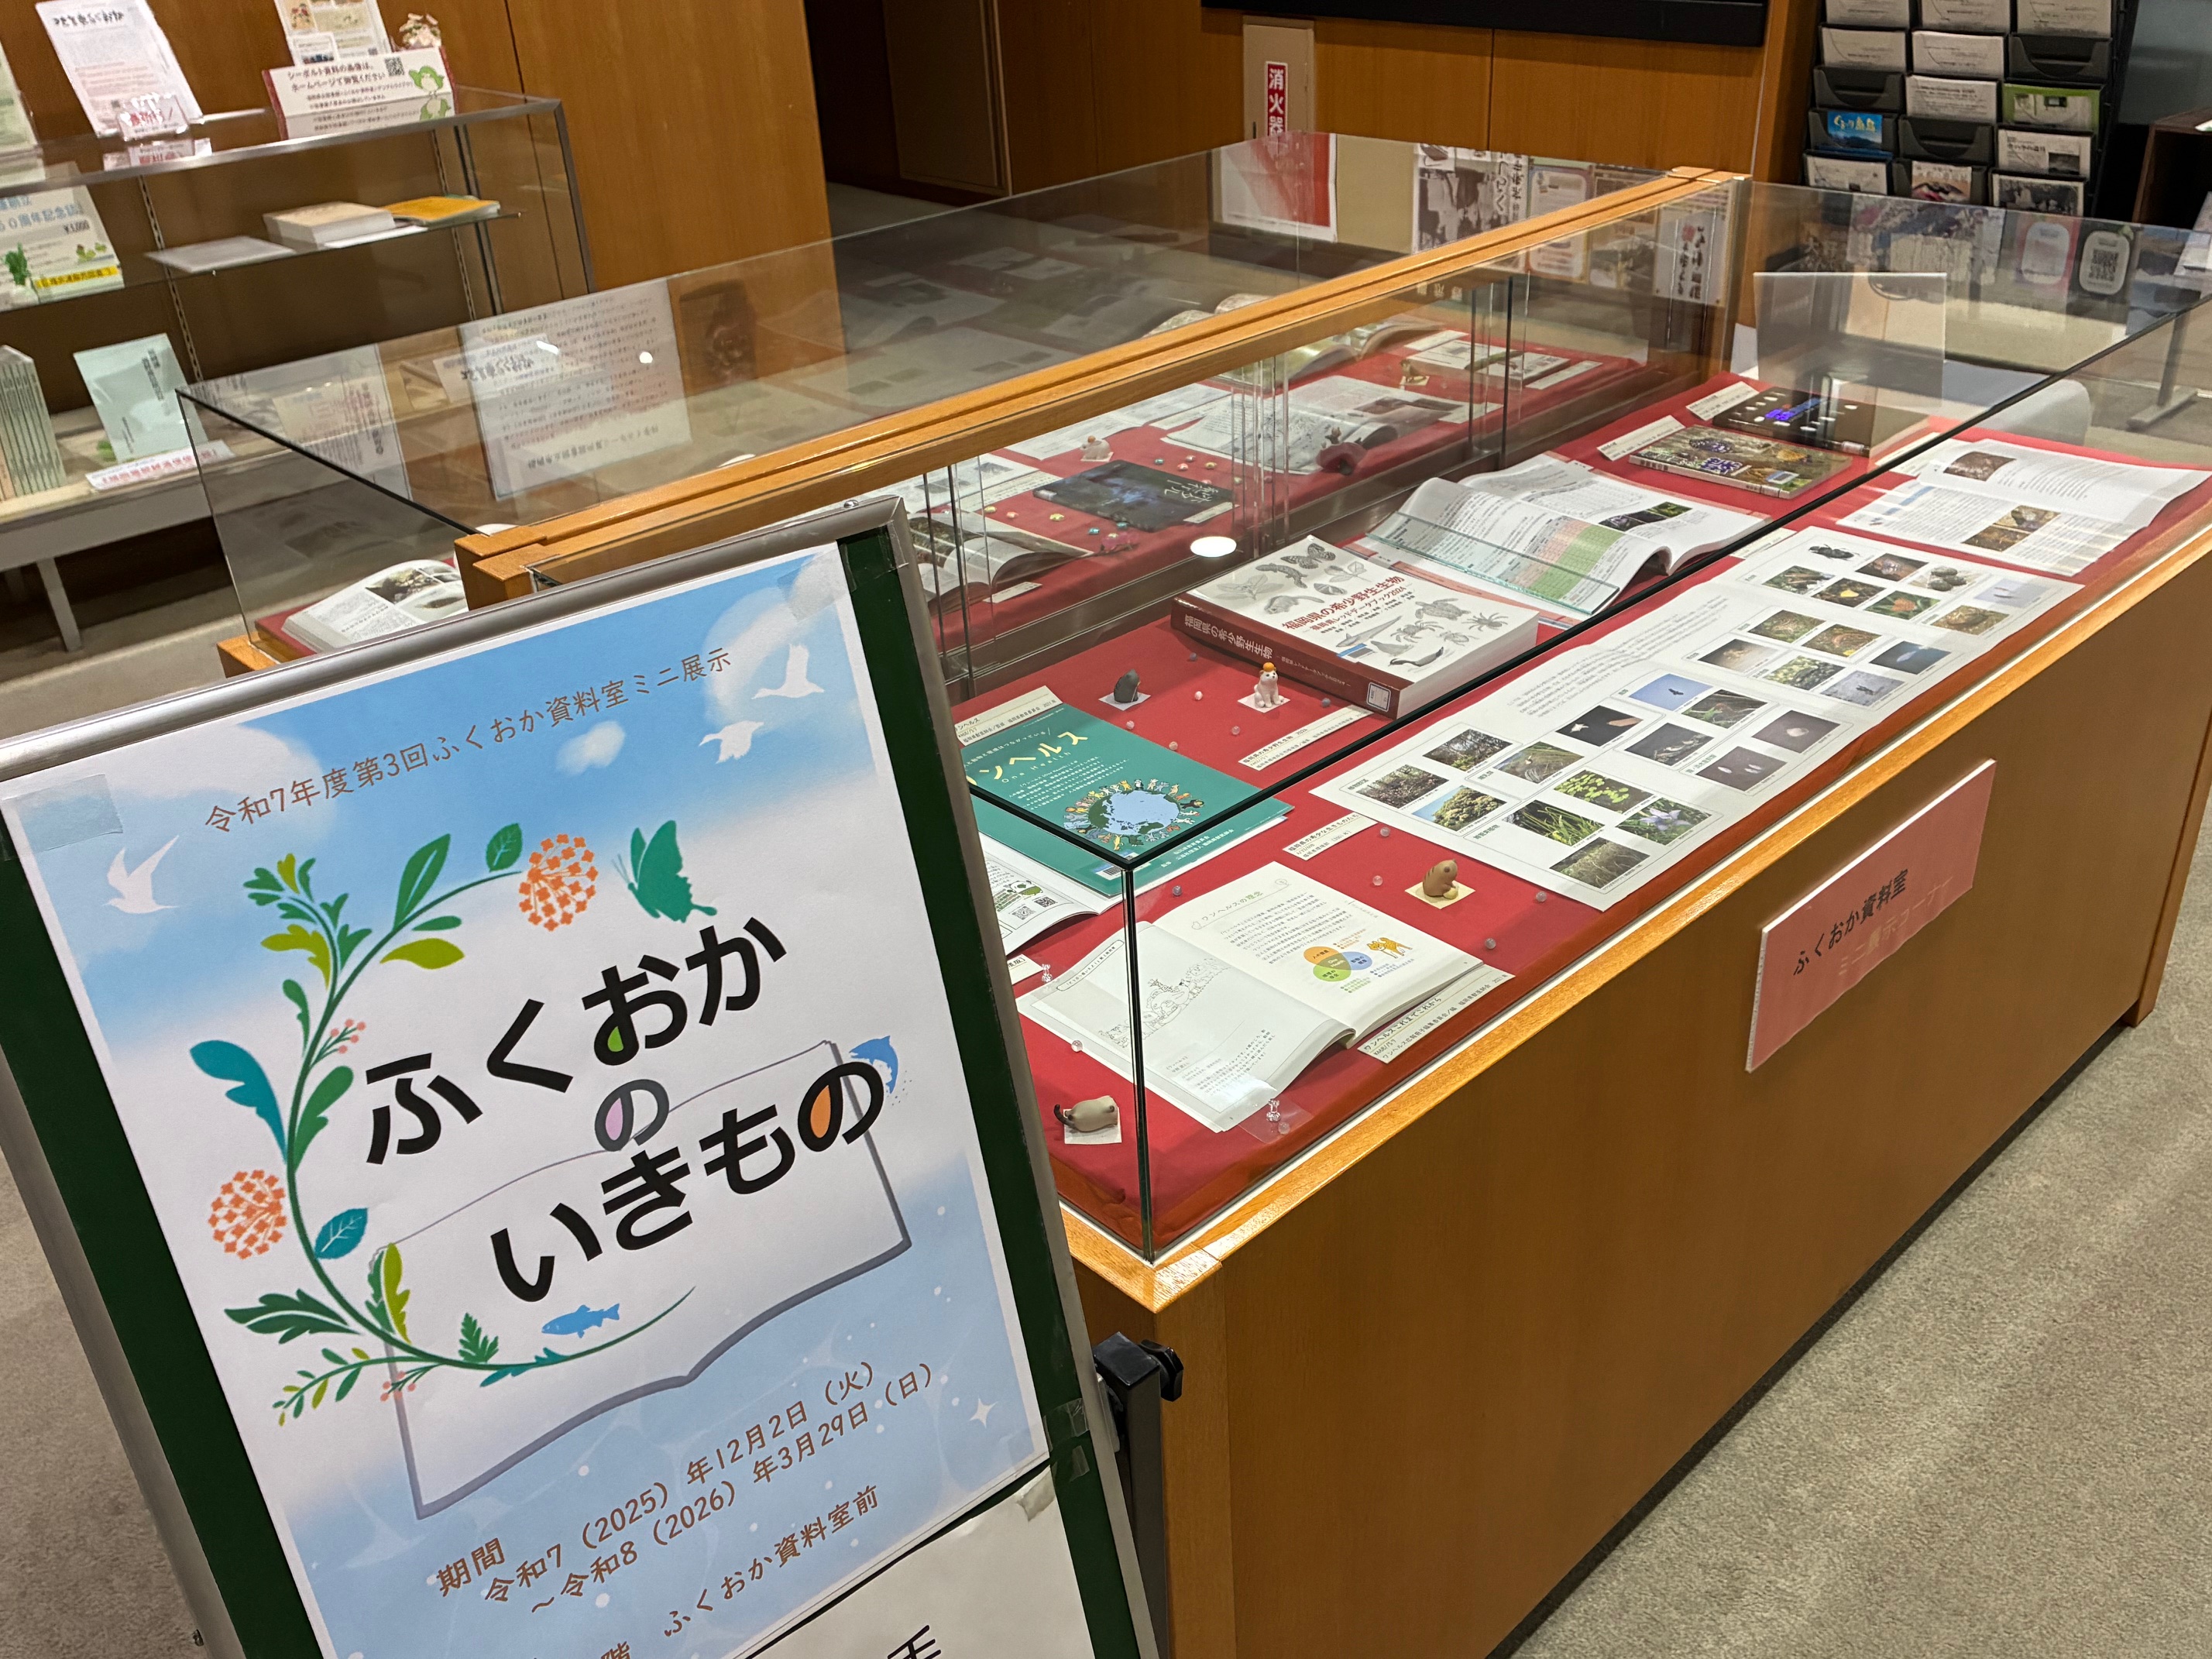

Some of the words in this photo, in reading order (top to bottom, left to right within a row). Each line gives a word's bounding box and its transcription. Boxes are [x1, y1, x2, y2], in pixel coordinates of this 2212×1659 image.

[1269, 68, 1284, 138] 消火器
[1184, 614, 1274, 659] 福岡県の希少野生生物
[1282, 575, 1406, 630] 福岡県の希少野生生物
[204, 644, 733, 836] 令和7年度第3回ふくおか資料室ミニ展示
[1793, 868, 1909, 977] ふくおか資料室
[366, 917, 787, 1165] ふくおか
[1363, 996, 1443, 1052] ワンヘルスこれまでこれから
[594, 1077, 670, 1152] の
[489, 1060, 886, 1303] いきもの
[435, 1537, 507, 1599] 期間
[664, 1484, 881, 1639] ふくおか資料室前
